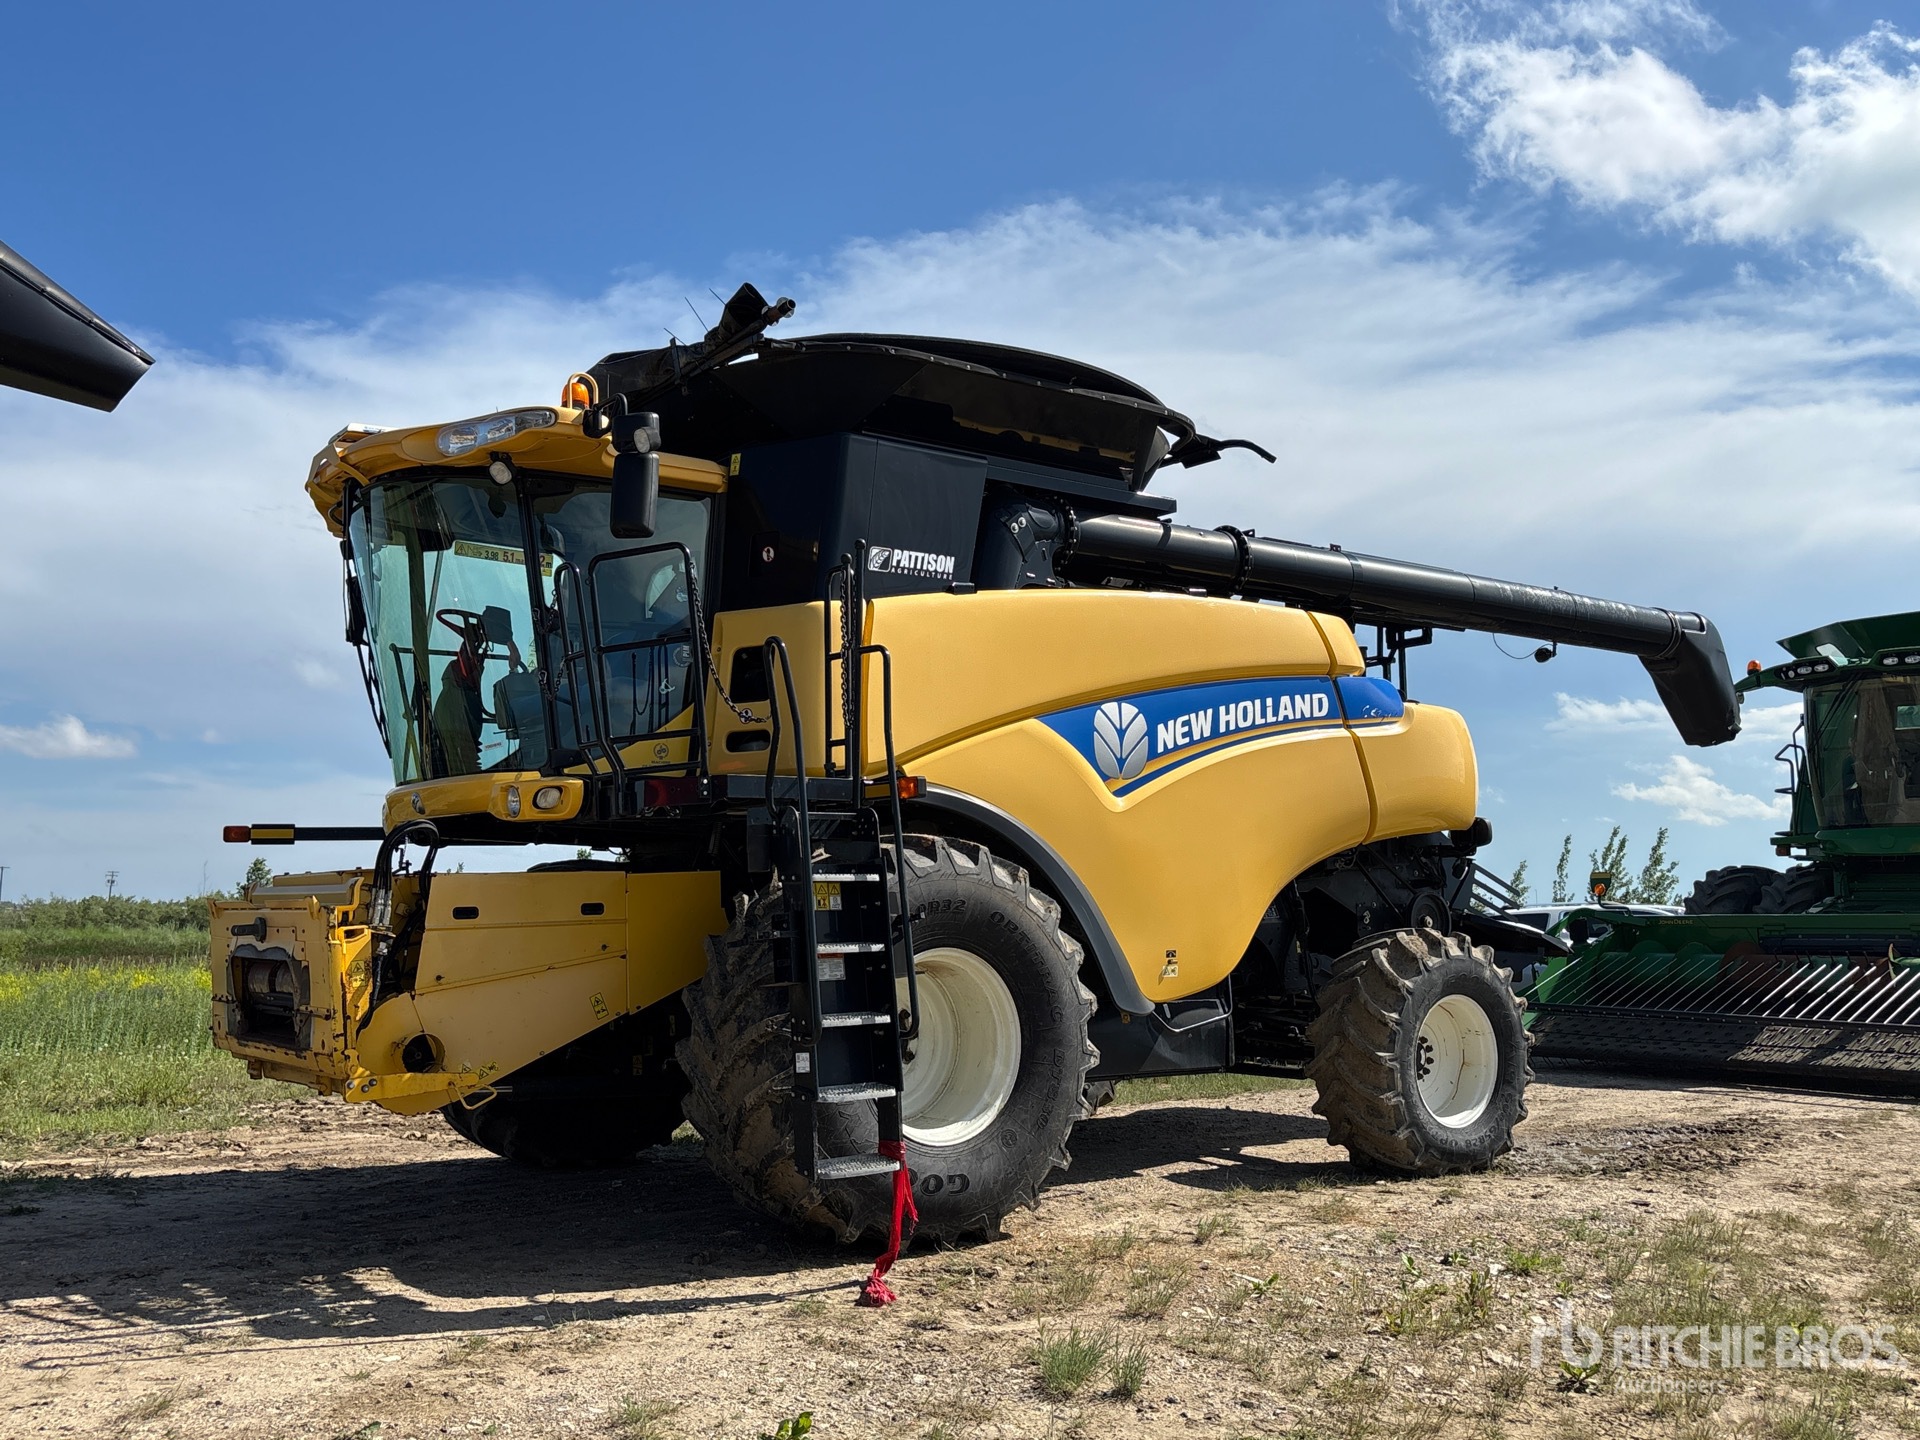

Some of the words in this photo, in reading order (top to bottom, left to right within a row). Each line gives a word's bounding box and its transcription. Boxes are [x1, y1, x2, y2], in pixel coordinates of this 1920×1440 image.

[891, 567, 953, 580] AGRICULTURE
[892, 549, 955, 574] PATTISON
[1157, 708, 1212, 754] NEW
[1218, 693, 1329, 733] HOLLAND
